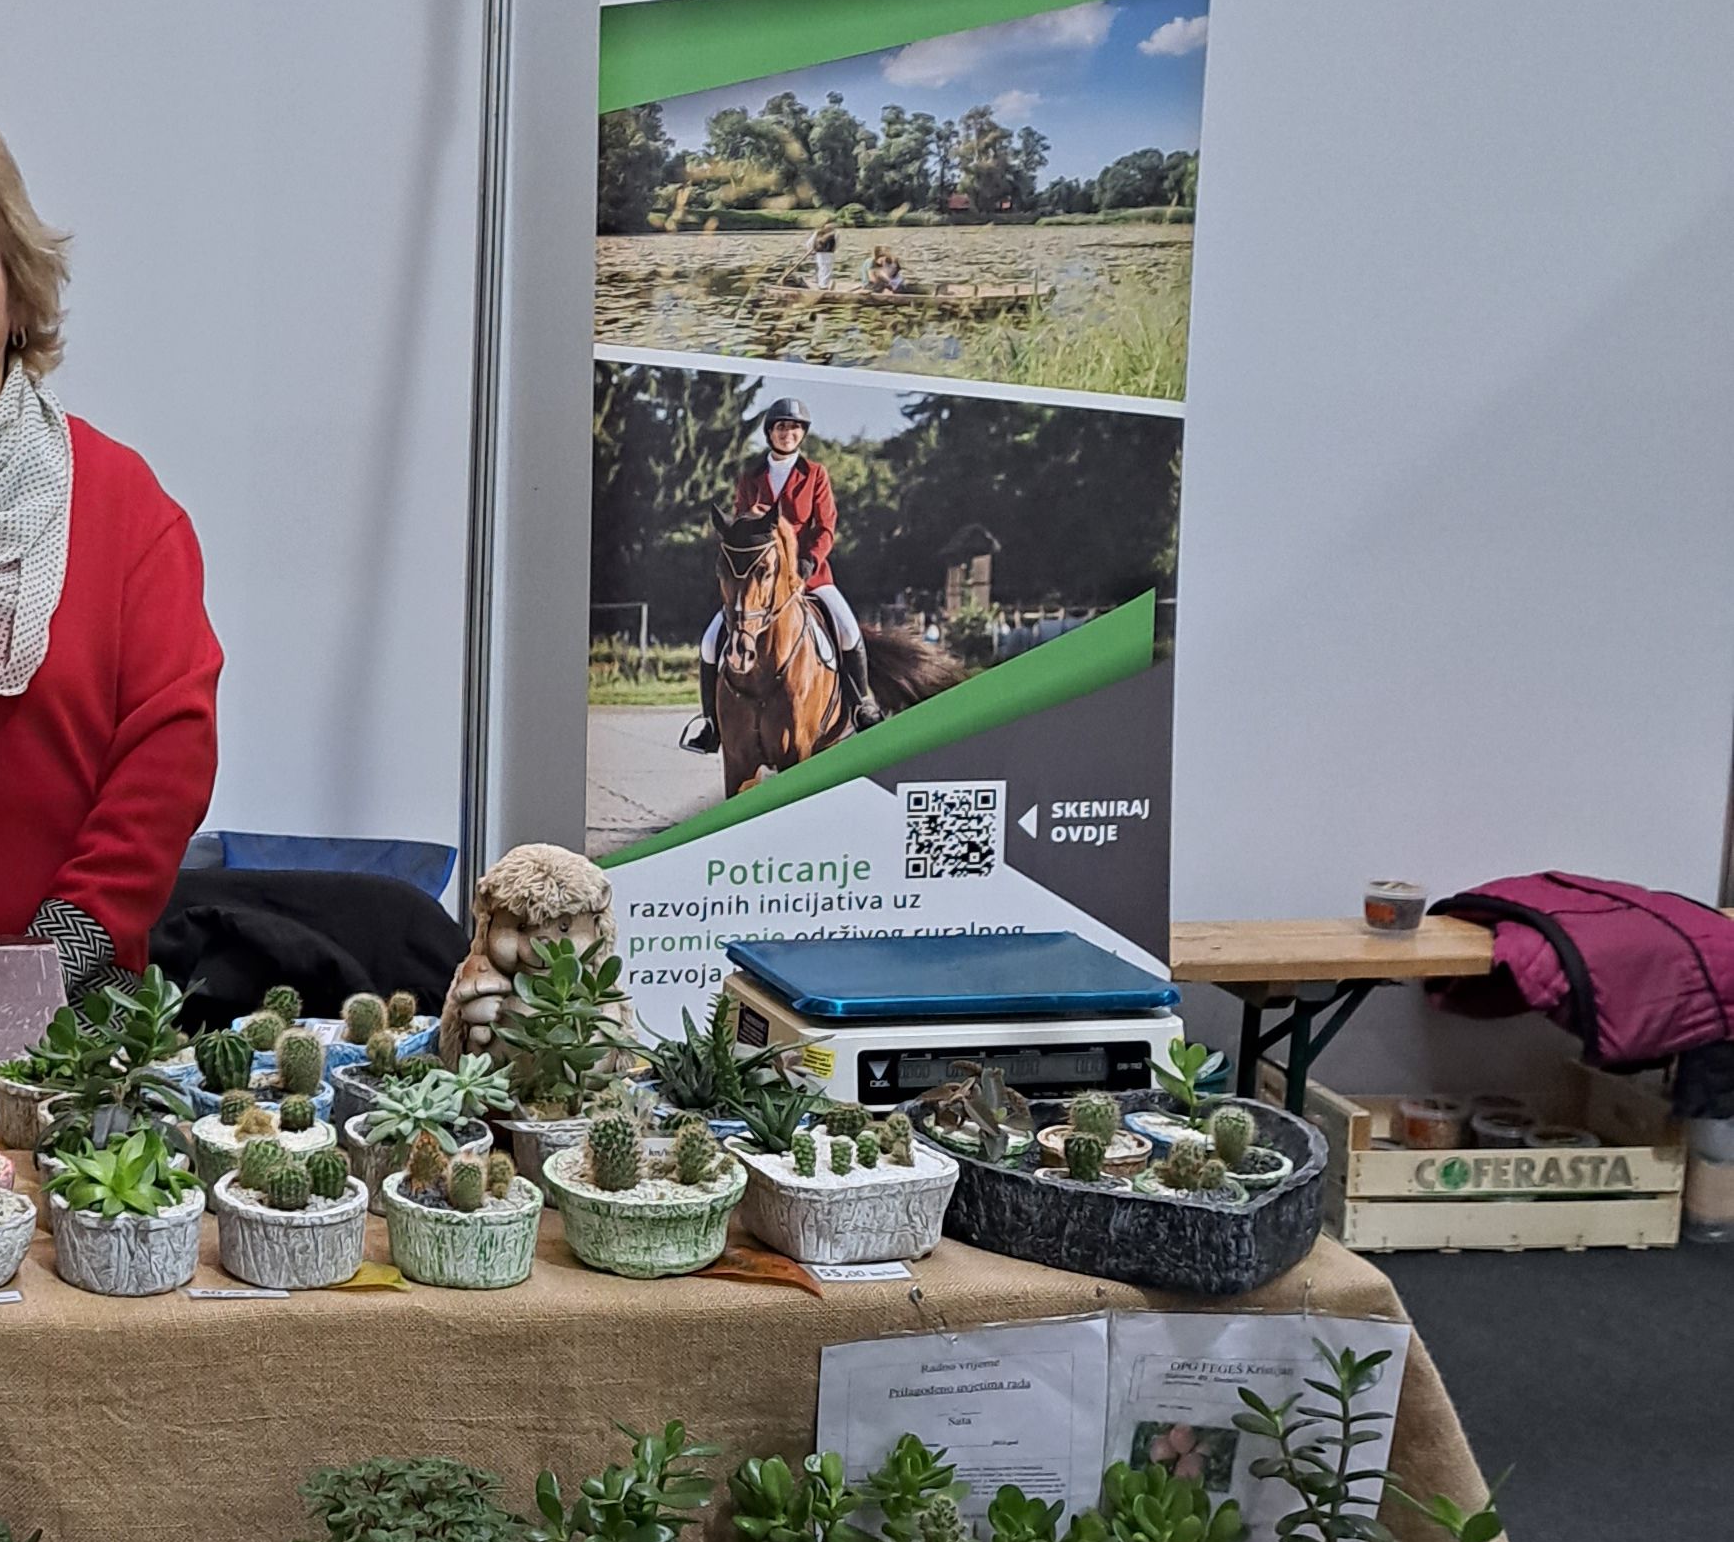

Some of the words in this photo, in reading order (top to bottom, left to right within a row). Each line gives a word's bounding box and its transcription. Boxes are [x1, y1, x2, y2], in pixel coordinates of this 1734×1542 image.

[1051, 798, 1150, 820] SKENIRAJ
[1050, 824, 1118, 847] OVDJE
[707, 853, 872, 890] Poticanje
[630, 894, 749, 923] razvojnih
[759, 891, 883, 918] inicijativa
[893, 893, 922, 910] uz
[629, 963, 722, 989] razvoja
